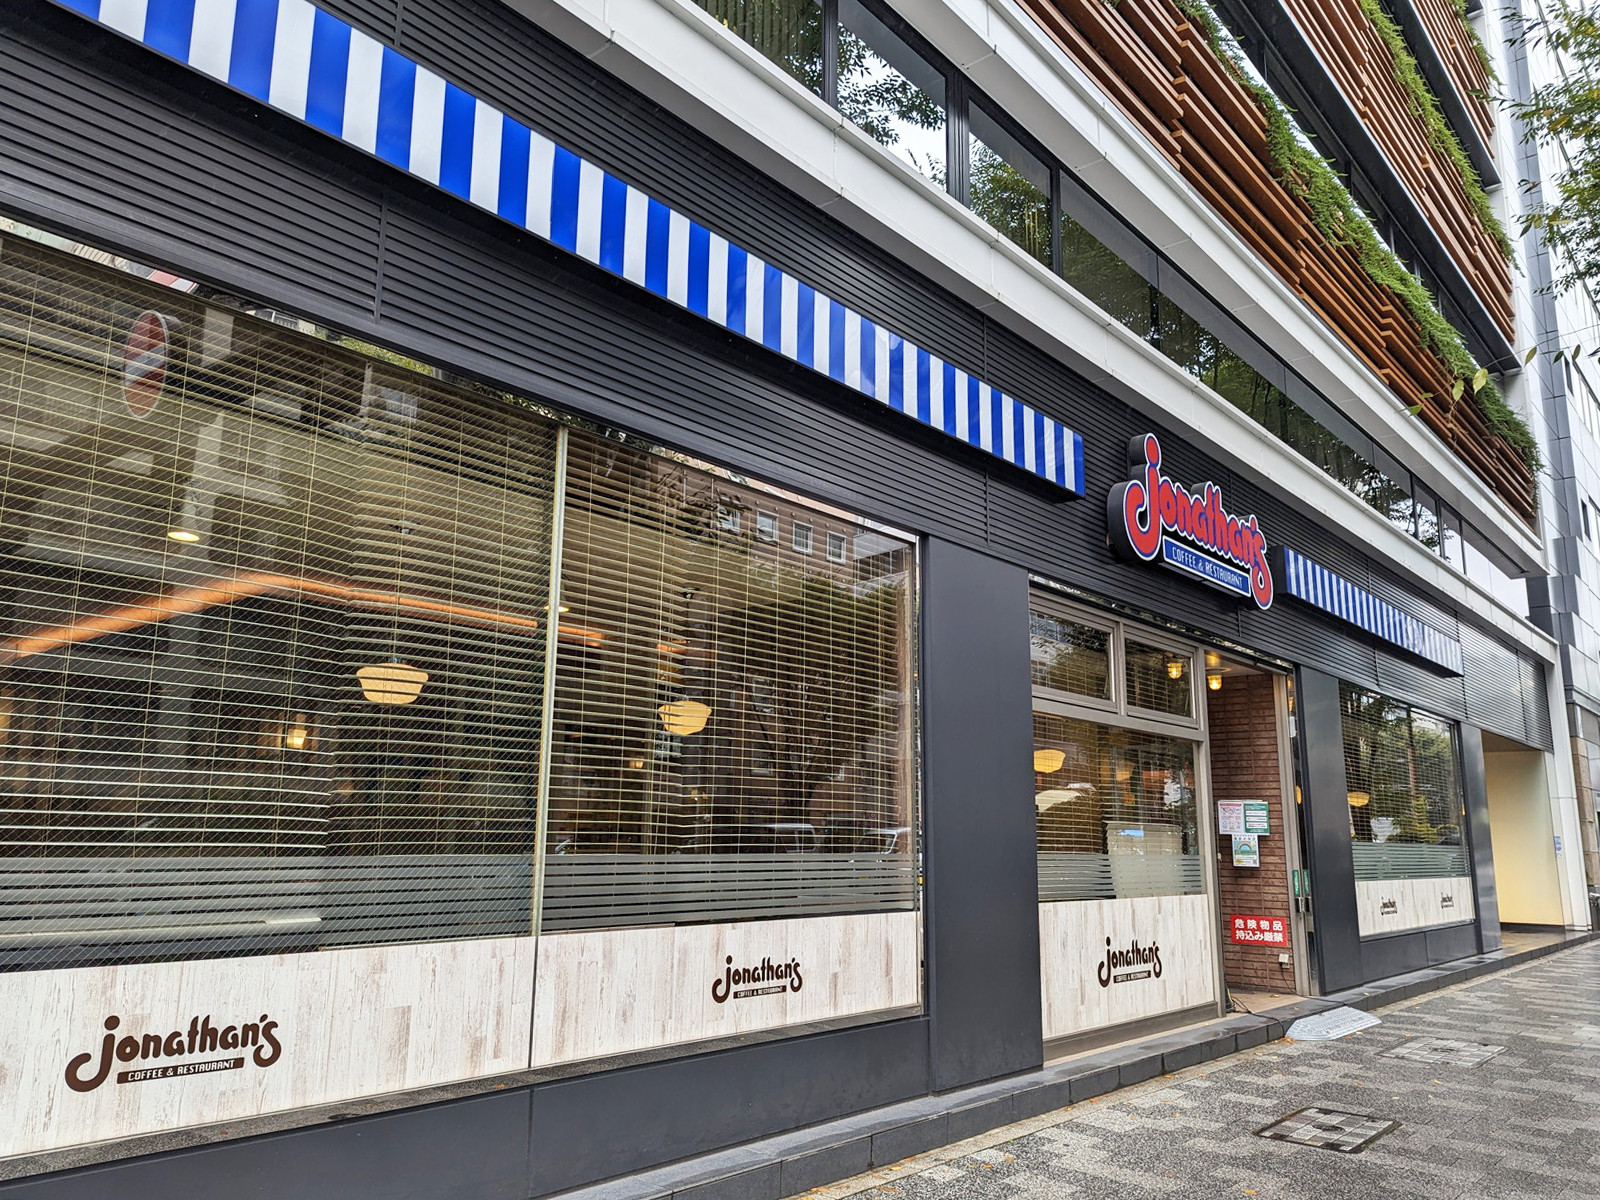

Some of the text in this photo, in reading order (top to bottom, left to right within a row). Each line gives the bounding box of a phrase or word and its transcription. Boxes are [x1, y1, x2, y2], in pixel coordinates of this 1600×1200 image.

[1123, 433, 1273, 610] jonathan's
[1172, 546, 1243, 589] COFFEE & RESTAURANT
[711, 954, 803, 1004] jonathan's
[1097, 936, 1163, 988] jonathan's
[64, 1013, 282, 1093] jonathan's
[127, 1059, 236, 1082] COFFEE & RESTAURANT
